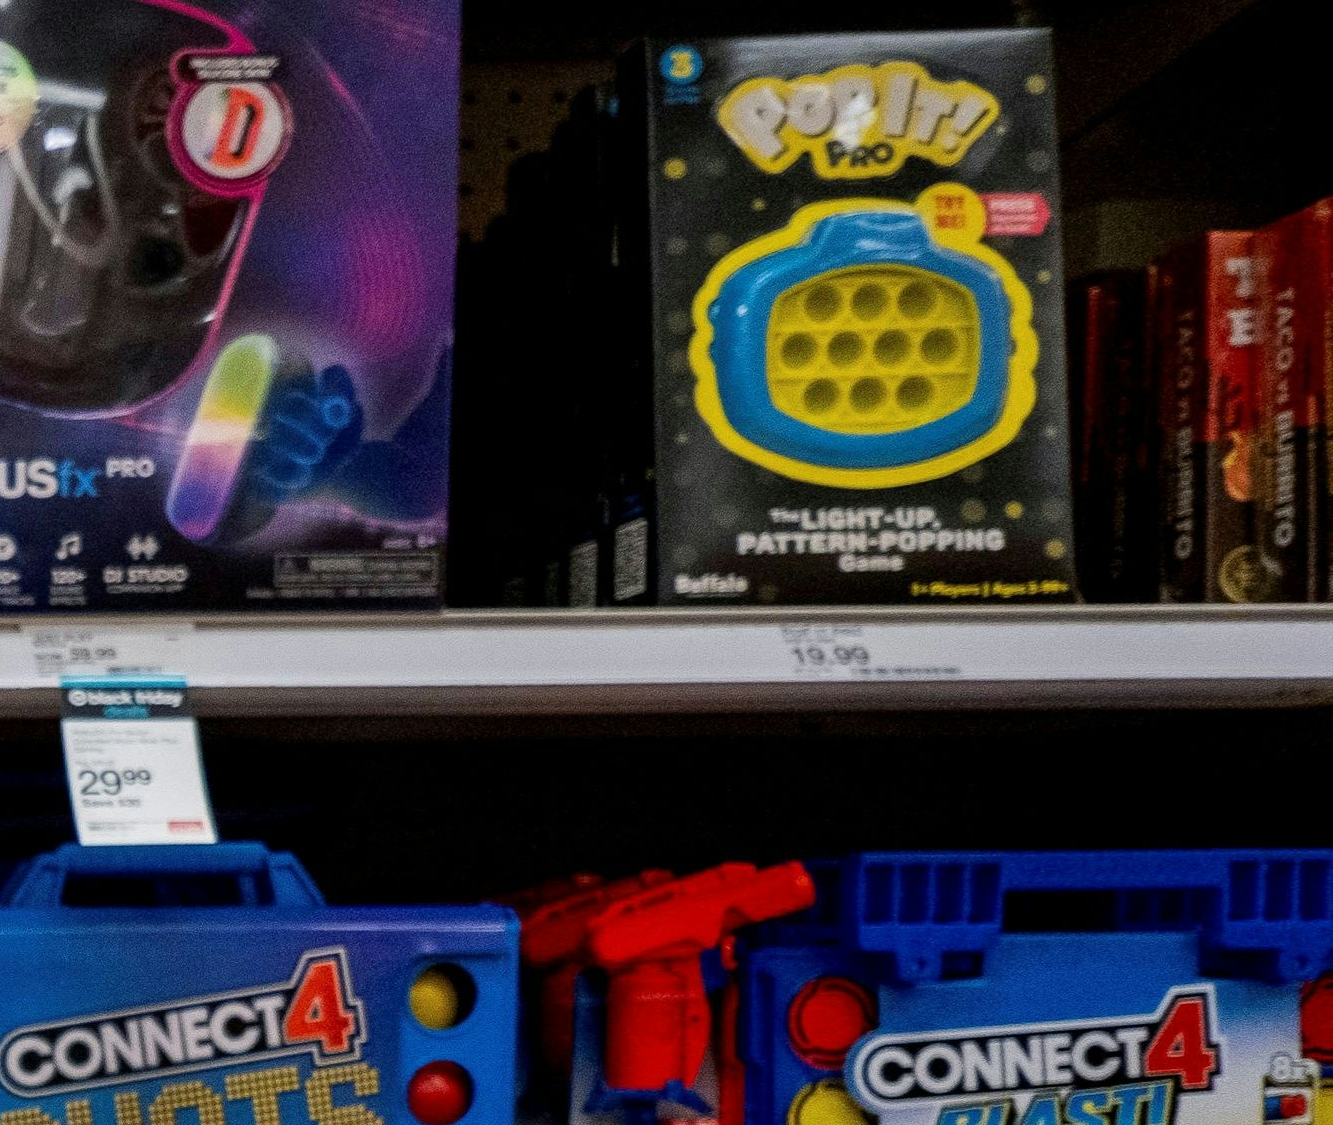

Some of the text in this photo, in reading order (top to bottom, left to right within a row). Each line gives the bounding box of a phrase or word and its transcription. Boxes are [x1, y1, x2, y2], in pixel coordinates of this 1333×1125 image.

[731, 72, 879, 162] POP
[823, 140, 895, 168] PRO
[1275, 286, 1295, 371] TACO
[104, 456, 156, 480] PRO
[1273, 410, 1296, 548] BURRITO
[735, 527, 1006, 556] PATTERN-POPPING
[126, 565, 190, 585] STUDIO
[837, 553, 907, 573] Game
[673, 571, 750, 595] Buffalo
[789, 645, 870, 668] 19.99
[4, 958, 356, 1087] CONNECT 4
[867, 998, 1218, 1099] CONNECT 4
